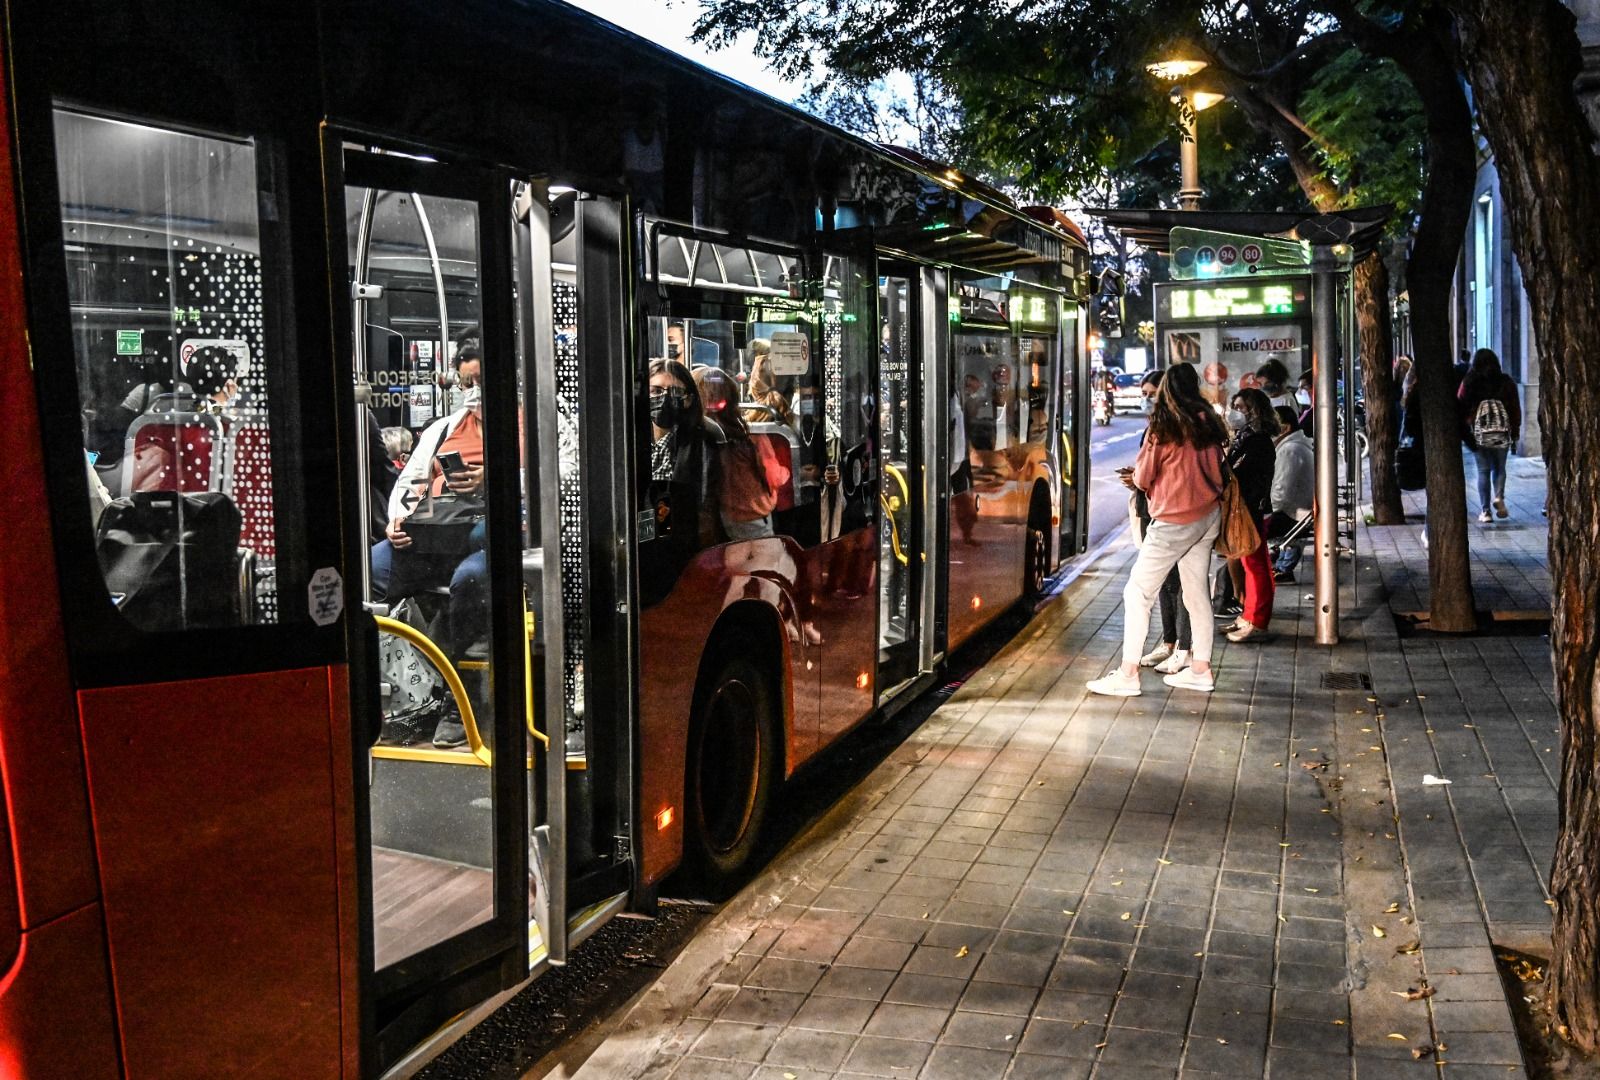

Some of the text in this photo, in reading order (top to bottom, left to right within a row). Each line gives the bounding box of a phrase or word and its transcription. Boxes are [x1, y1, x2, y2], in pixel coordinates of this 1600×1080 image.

[1061, 243, 1074, 264] EMT
[1201, 248, 1258, 261] 11 94 80
[1222, 337, 1294, 352] MENÚ 4YOU
